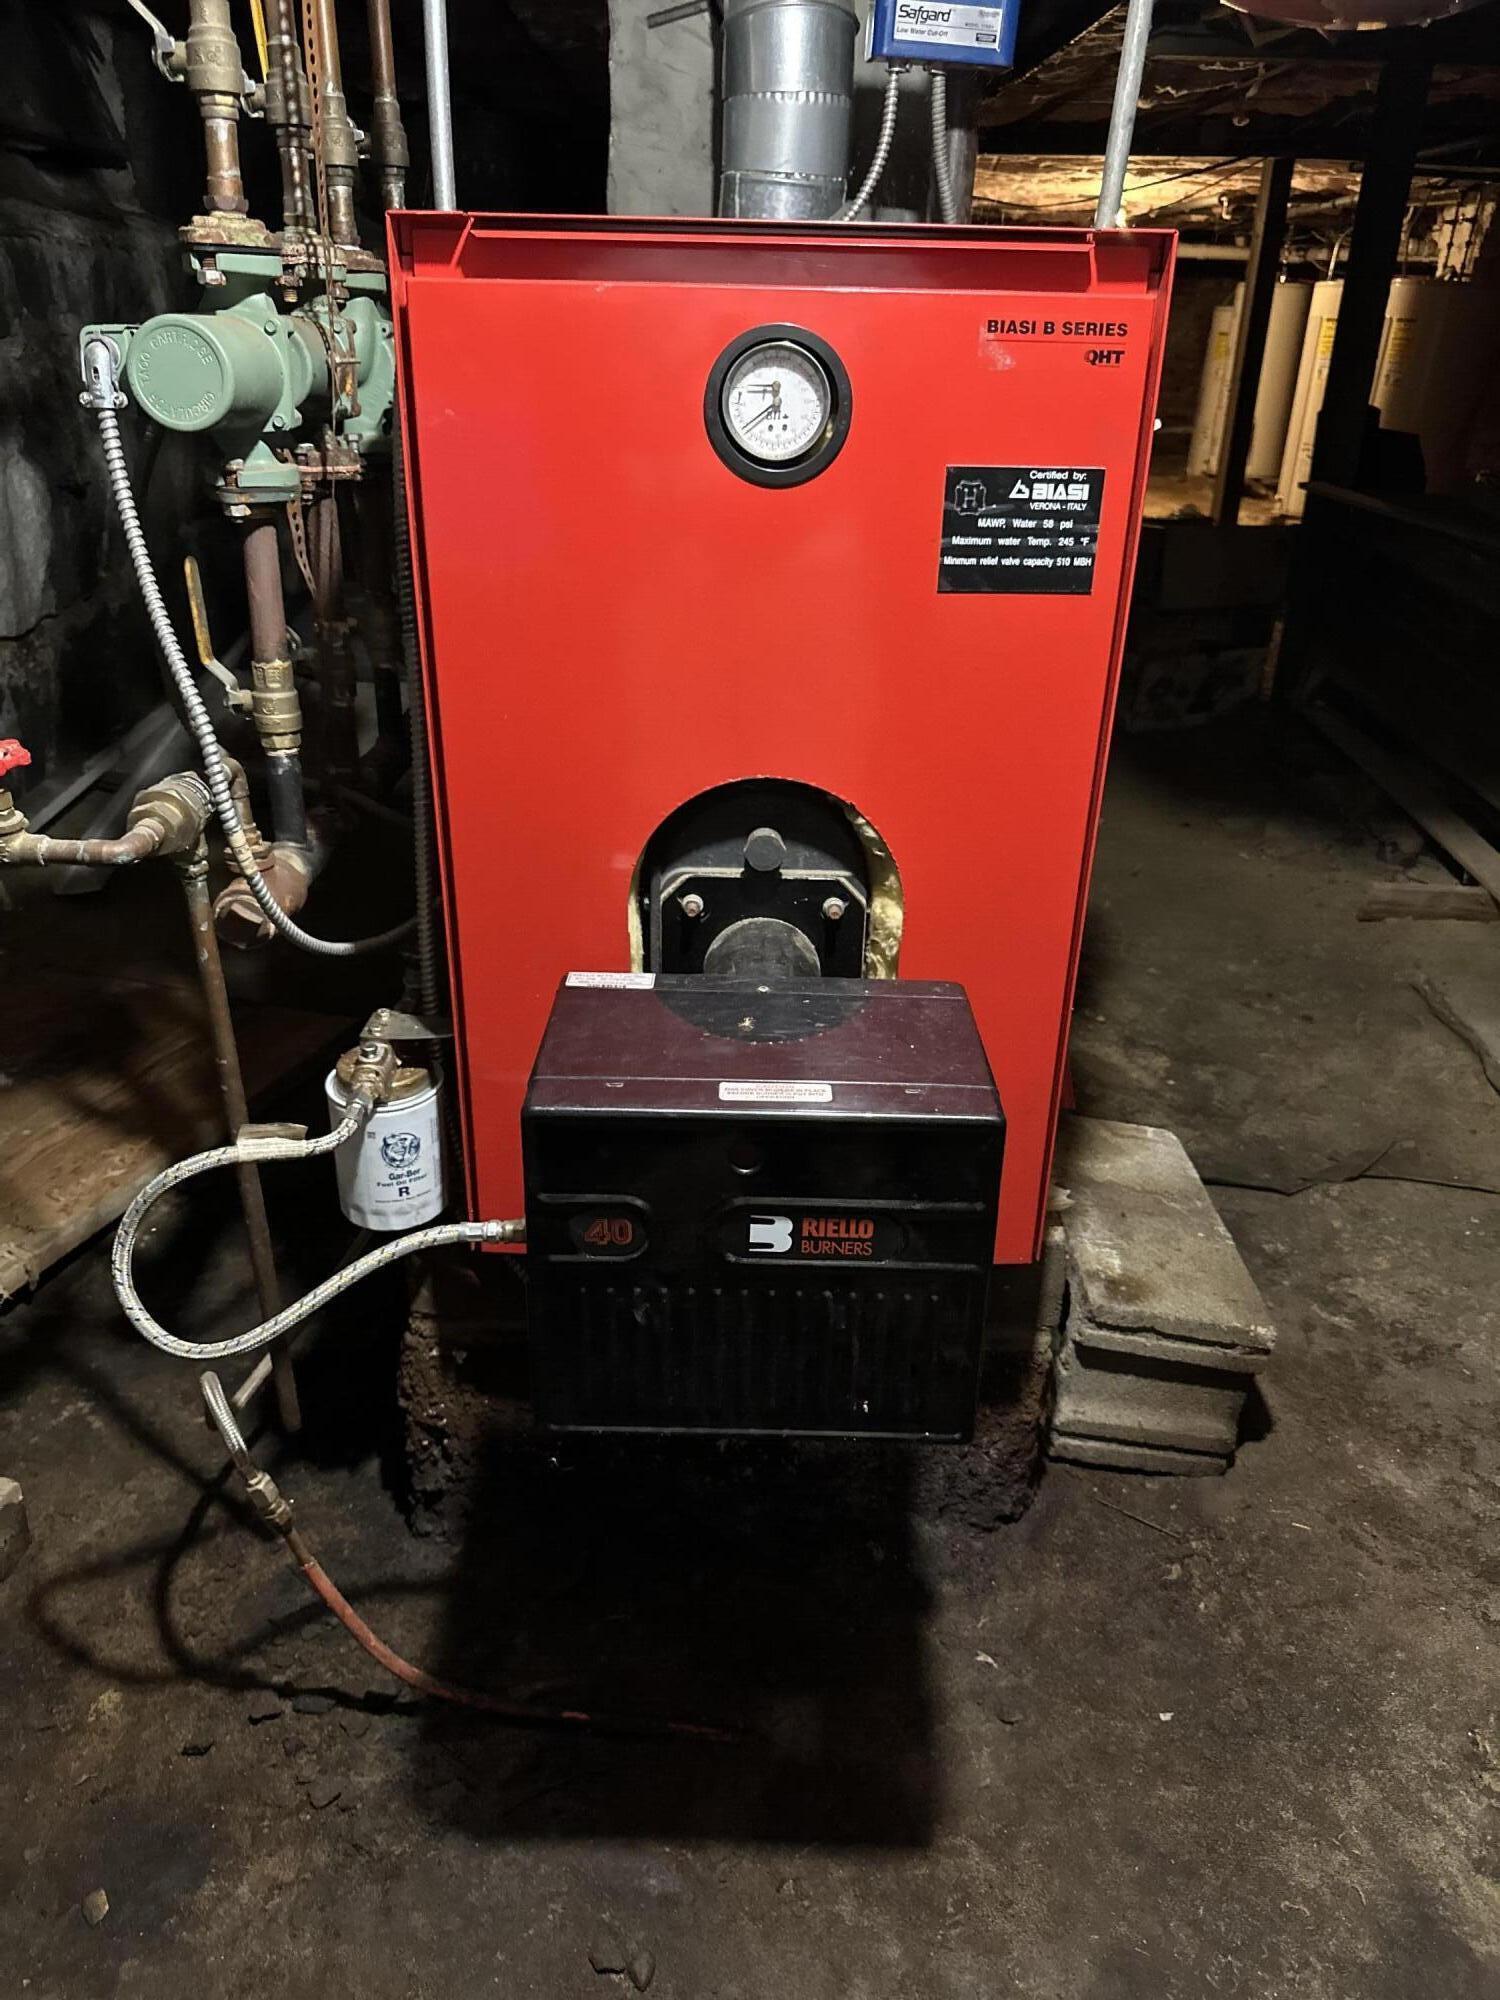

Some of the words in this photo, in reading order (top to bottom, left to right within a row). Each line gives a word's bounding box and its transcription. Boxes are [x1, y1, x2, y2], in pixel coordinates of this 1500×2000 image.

[898, 4, 951, 24] Safgard
[987, 320, 1036, 334] BIASI
[1043, 321, 1055, 335] B
[1062, 322, 1128, 337] SERIES
[1085, 350, 1125, 366] QHT
[1029, 470, 1068, 480] Certified
[1072, 472, 1087, 481] by:
[1032, 483, 1090, 501] BIASI
[1030, 503, 1061, 511] VERONA
[1067, 503, 1087, 511] ITALY
[1013, 519, 1037, 529] Water
[1043, 519, 1054, 529] 58
[1060, 519, 1073, 530] psi
[952, 536, 992, 546] Maximum
[998, 537, 1021, 546] water
[1028, 537, 1052, 547] Temp.
[1058, 538, 1074, 546] 245
[980, 556, 998, 566] relief
[1001, 557, 1020, 566] valve
[1023, 557, 1054, 567] capacity
[1073, 557, 1092, 566] MBH
[388, 1168, 421, 1180] Gar-Ber
[409, 1174, 427, 1183] Filter
[398, 1186, 410, 1197] R
[584, 1217, 633, 1246] 40
[801, 1216, 875, 1240] RIELLO
[801, 1240, 873, 1257] BURNERS
